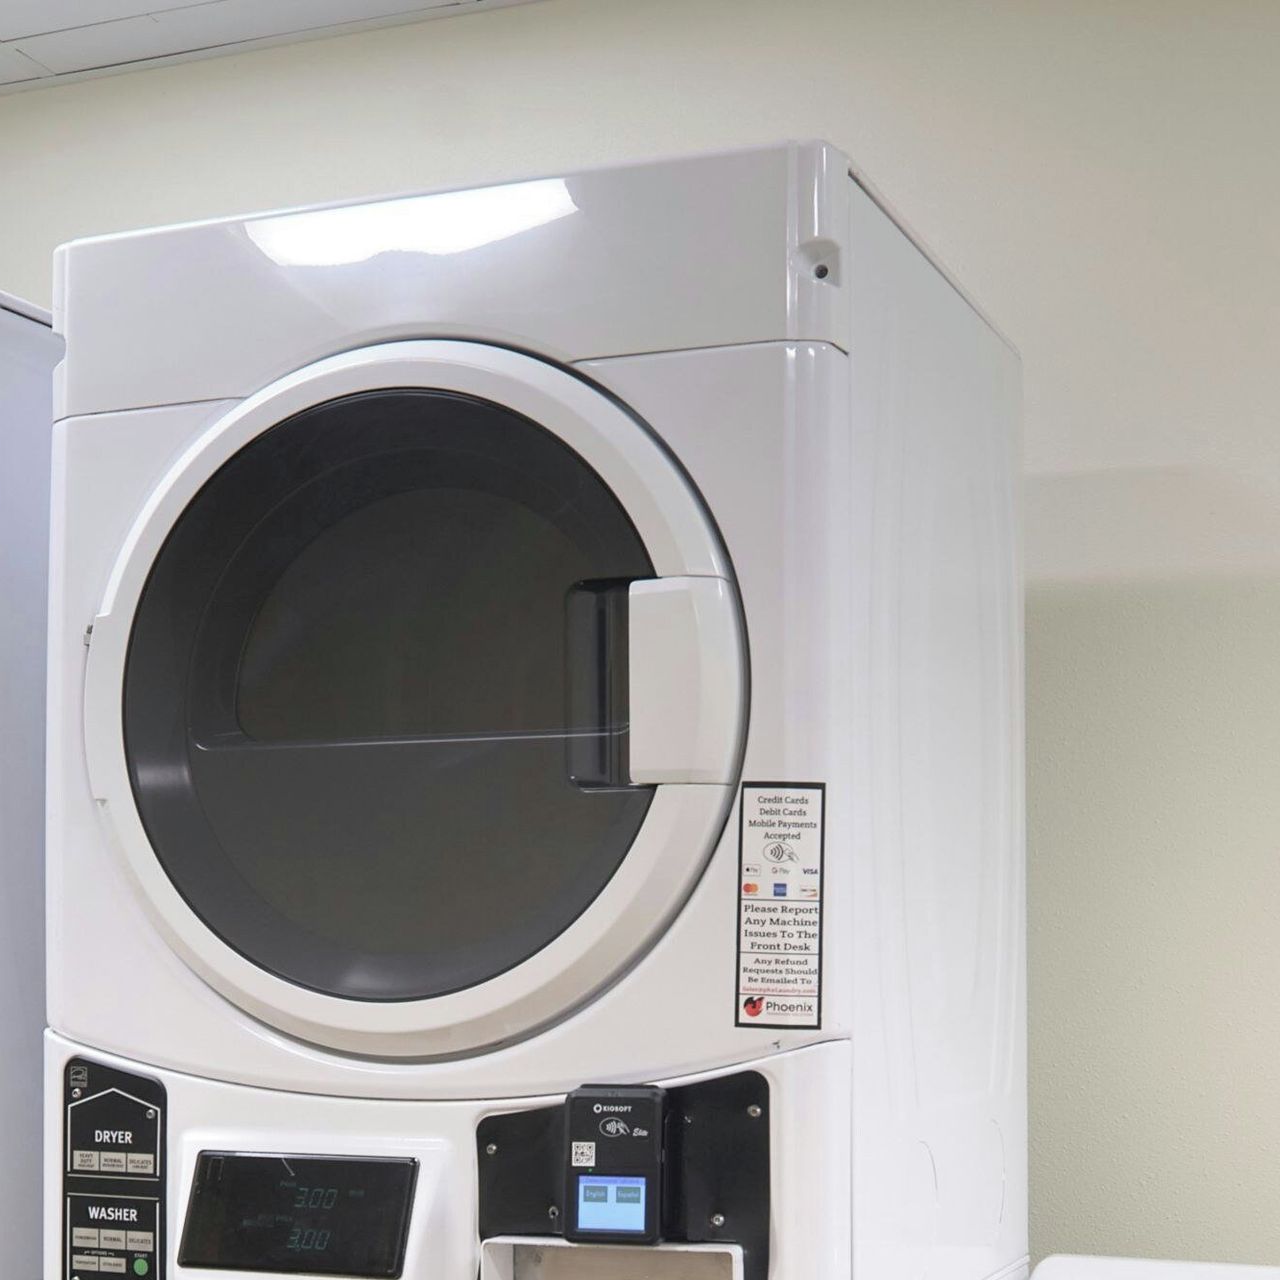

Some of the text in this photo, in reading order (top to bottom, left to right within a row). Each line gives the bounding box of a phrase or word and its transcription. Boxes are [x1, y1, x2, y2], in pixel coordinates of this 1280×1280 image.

[757, 796, 809, 805] Credit Cards
[759, 808, 807, 817] Debit Cards
[748, 820, 817, 830] Mobile Payments
[764, 832, 801, 841] Accepted
[744, 904, 819, 915] Please Report
[744, 917, 818, 927] Any Machine
[744, 929, 818, 939] Issues To The
[750, 942, 811, 951] Front Desk
[754, 958, 808, 966] Any Refund
[742, 967, 783, 975] Requests
[766, 1001, 813, 1012] Phoenix
[602, 1105, 632, 1113] KIOSOFT
[94, 1129, 133, 1144] DRYER
[294, 1187, 338, 1209] 3.00
[88, 1206, 138, 1222] WASHER
[287, 1228, 330, 1250] 3.00
